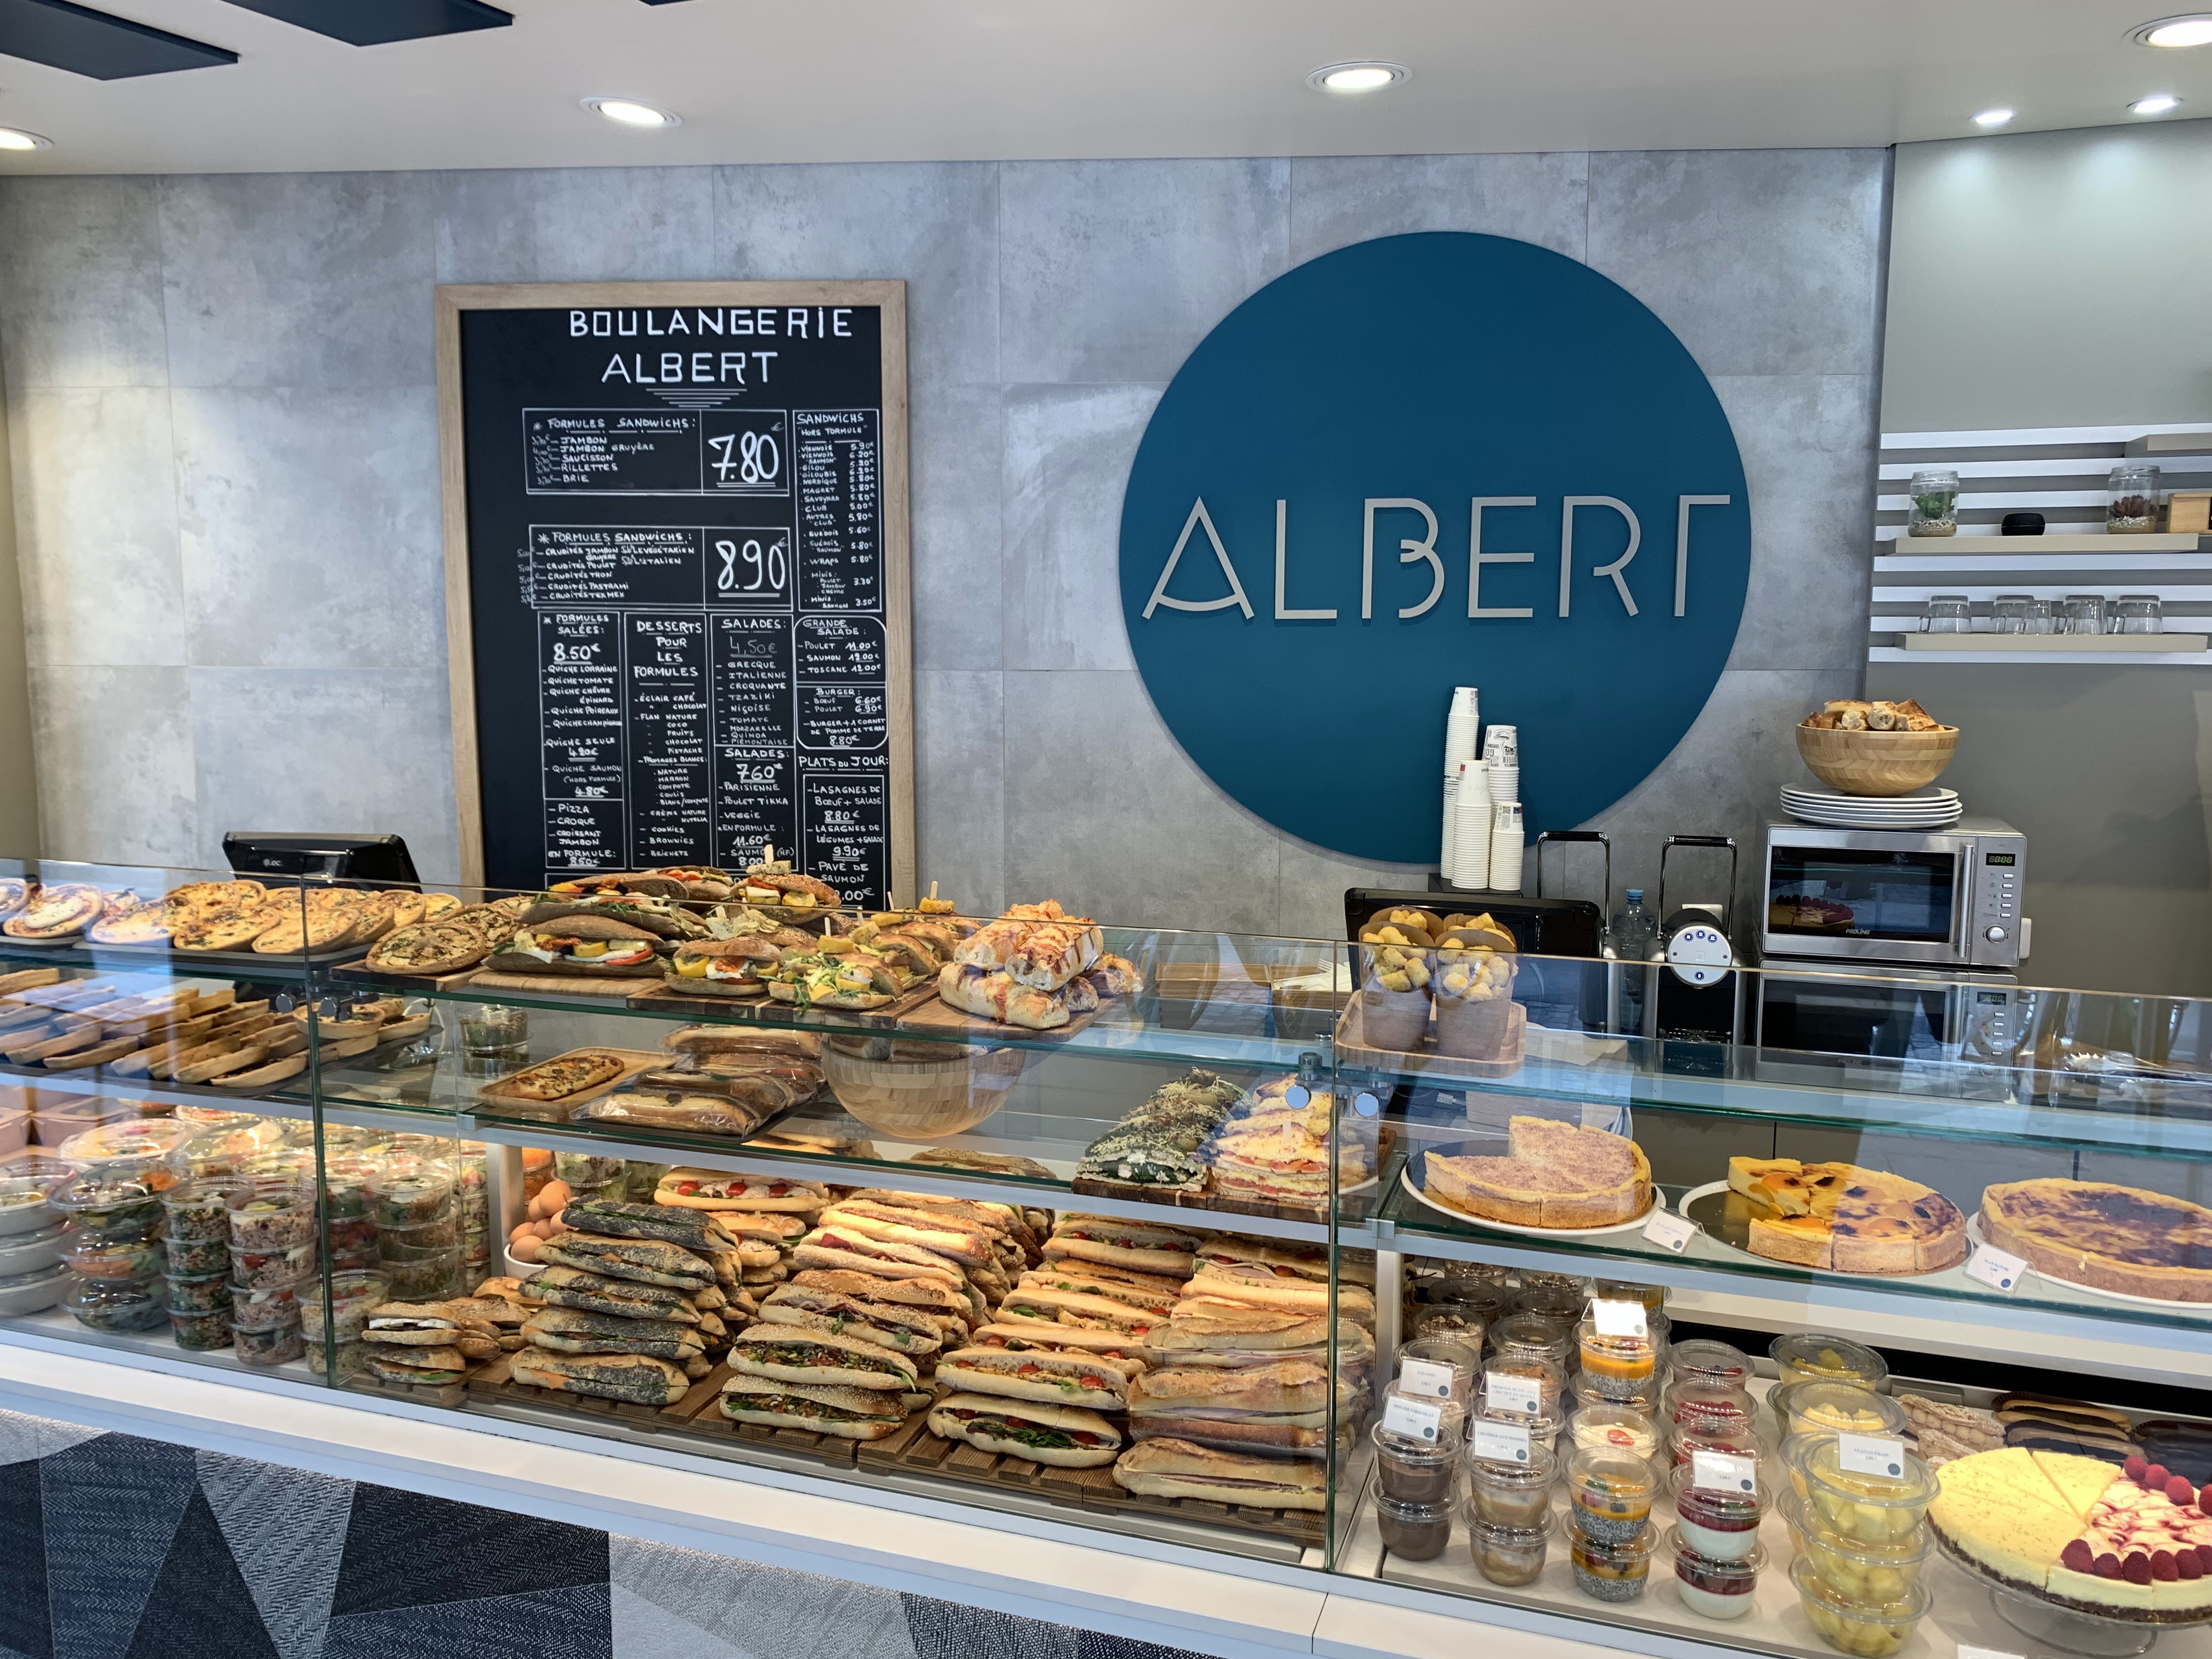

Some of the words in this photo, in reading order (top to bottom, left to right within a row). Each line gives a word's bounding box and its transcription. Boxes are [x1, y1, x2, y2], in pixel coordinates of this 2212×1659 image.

[569, 307, 852, 338] BOULANGERIE
[601, 351, 778, 384] ALBERT
[797, 413, 864, 424] SANDWICHS
[548, 417, 605, 430] FORMULES
[560, 437, 607, 445] JAMBON
[560, 445, 605, 453] JAMBON
[562, 454, 613, 462] SAUCISSON
[561, 463, 618, 472] RILLETTES
[562, 474, 589, 483] BRIE
[552, 532, 611, 542] FORMULES
[1142, 494, 1730, 620] ALBERT
[586, 561, 616, 569] POULET
[810, 558, 839, 566] WRAPS
[589, 582, 629, 590] PASTRAMI
[556, 614, 609, 623] FORMULES
[636, 620, 702, 634] DESSERTS
[803, 619, 848, 628] GRANDE
[656, 637, 686, 647] POUR
[804, 641, 836, 650] POULET
[658, 651, 683, 662] LES
[548, 664, 578, 674] QUICHE
[580, 664, 618, 673] LORRAINE
[634, 666, 698, 678] FORMULES
[729, 671, 787, 679] ITALIENNE
[548, 676, 578, 685] QUICHE
[729, 682, 786, 691] CROQUANTE
[549, 687, 580, 696] QUICHE
[640, 692, 669, 702] ÉCLAIR
[673, 691, 695, 702] CAFÉ
[728, 692, 775, 701] TZAZIKI
[551, 706, 584, 715] QUICHE
[585, 706, 619, 715] POIREAUX
[731, 703, 771, 715] NIÇOISE
[552, 719, 583, 727] QUICHE
[667, 729, 693, 737] FRUITS
[546, 737, 581, 747] QUICHE
[585, 737, 615, 746] SEULE
[799, 757, 837, 768] PLATS
[552, 765, 585, 774] QUICHE
[724, 781, 780, 792] PARISIENNE
[813, 783, 867, 794] LASAGNES
[725, 797, 755, 806] POULET
[758, 795, 788, 806] TIKKA
[558, 803, 590, 814] PIZZA
[724, 810, 761, 820] VEGGIE
[557, 817, 595, 827] CROQUE
[556, 828, 601, 837] CROISSANT
[651, 825, 685, 833] COOKIES
[650, 836, 695, 845] BROWNIES
[816, 834, 854, 843] LÉGUMES
[651, 849, 689, 857] BEIGNETS
[821, 874, 865, 883] SAUMON
